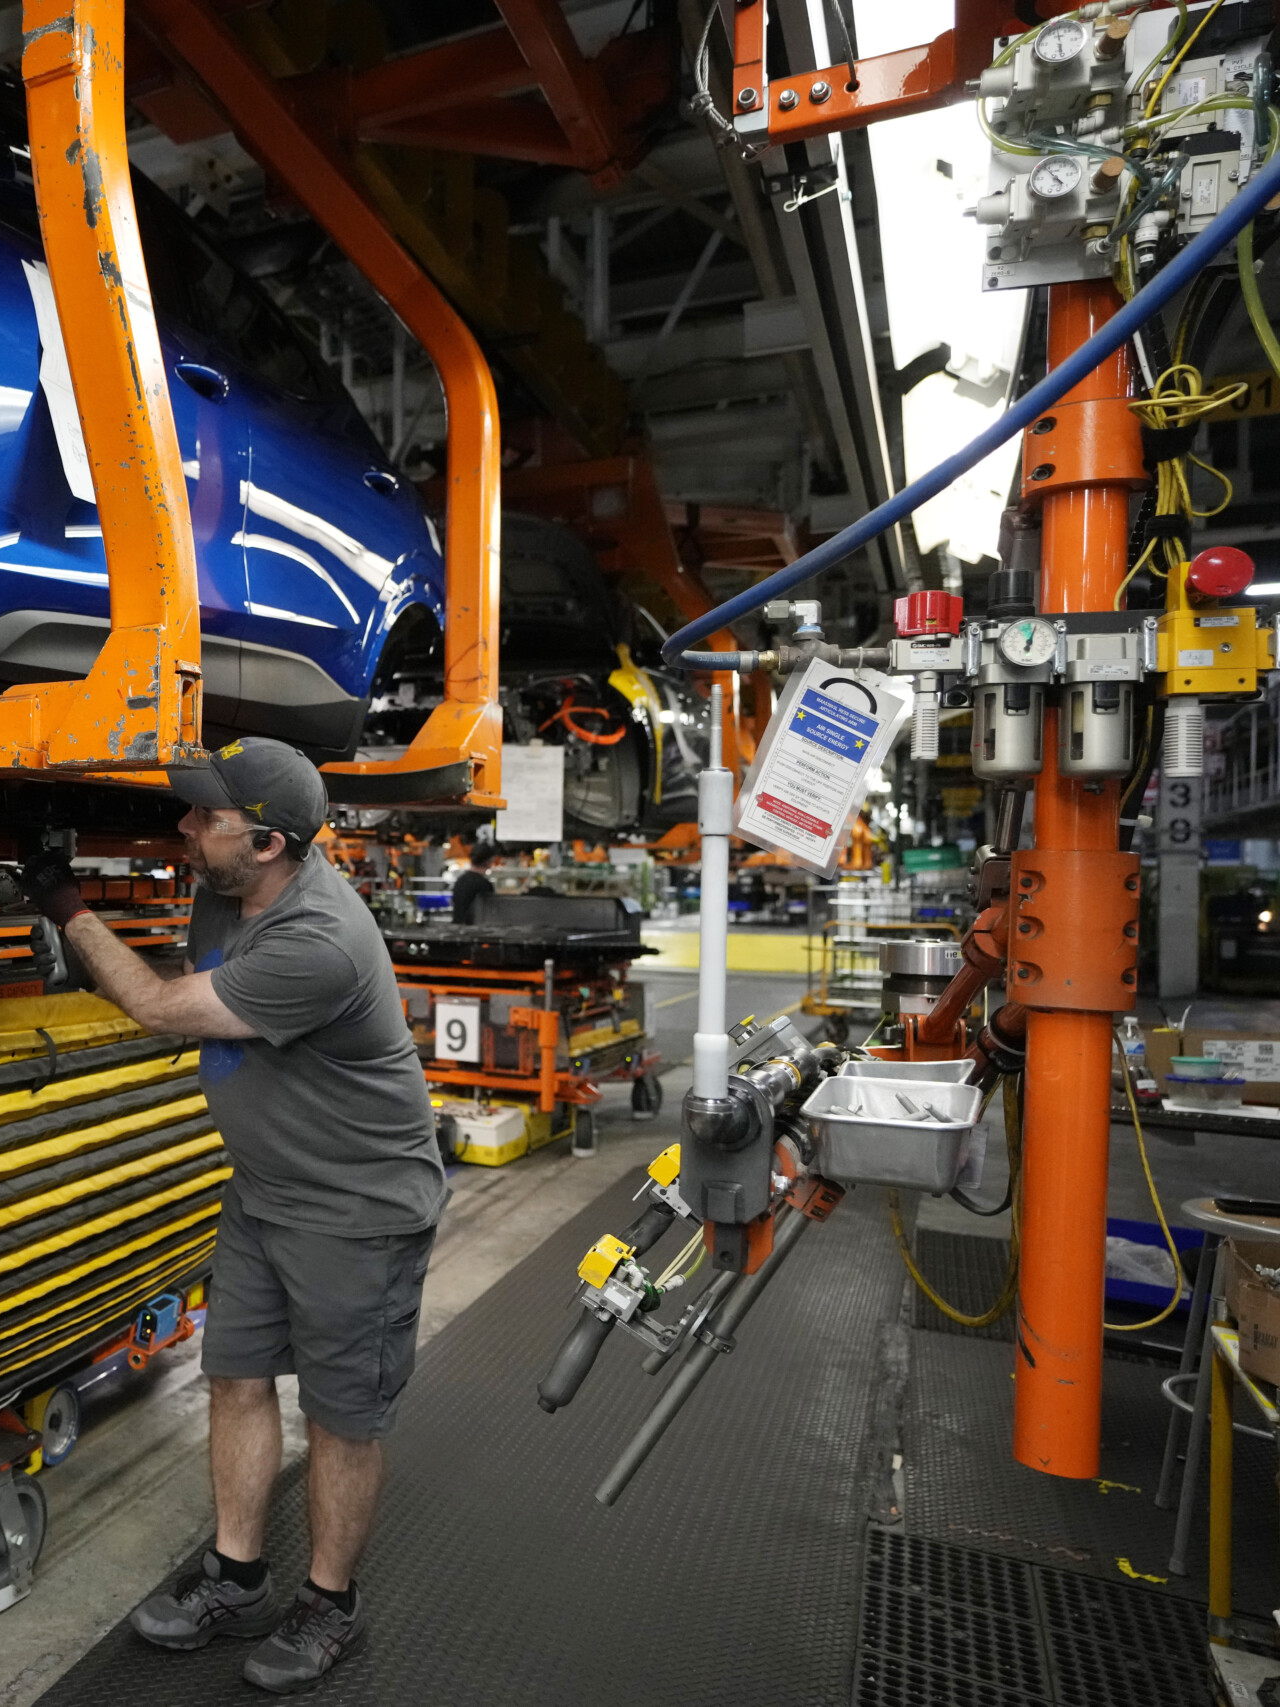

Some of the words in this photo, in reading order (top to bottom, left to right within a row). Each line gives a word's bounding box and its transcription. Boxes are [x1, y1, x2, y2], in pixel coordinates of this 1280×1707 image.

[819, 706, 848, 721] ARTICULATING
[806, 727, 827, 740] SOURCE
[827, 737, 849, 750] ENERGY
[826, 729, 845, 741] SINGLE
[815, 770, 830, 779] ACTION
[808, 792, 821, 800] VERIFY
[444, 1018, 468, 1053] 9
